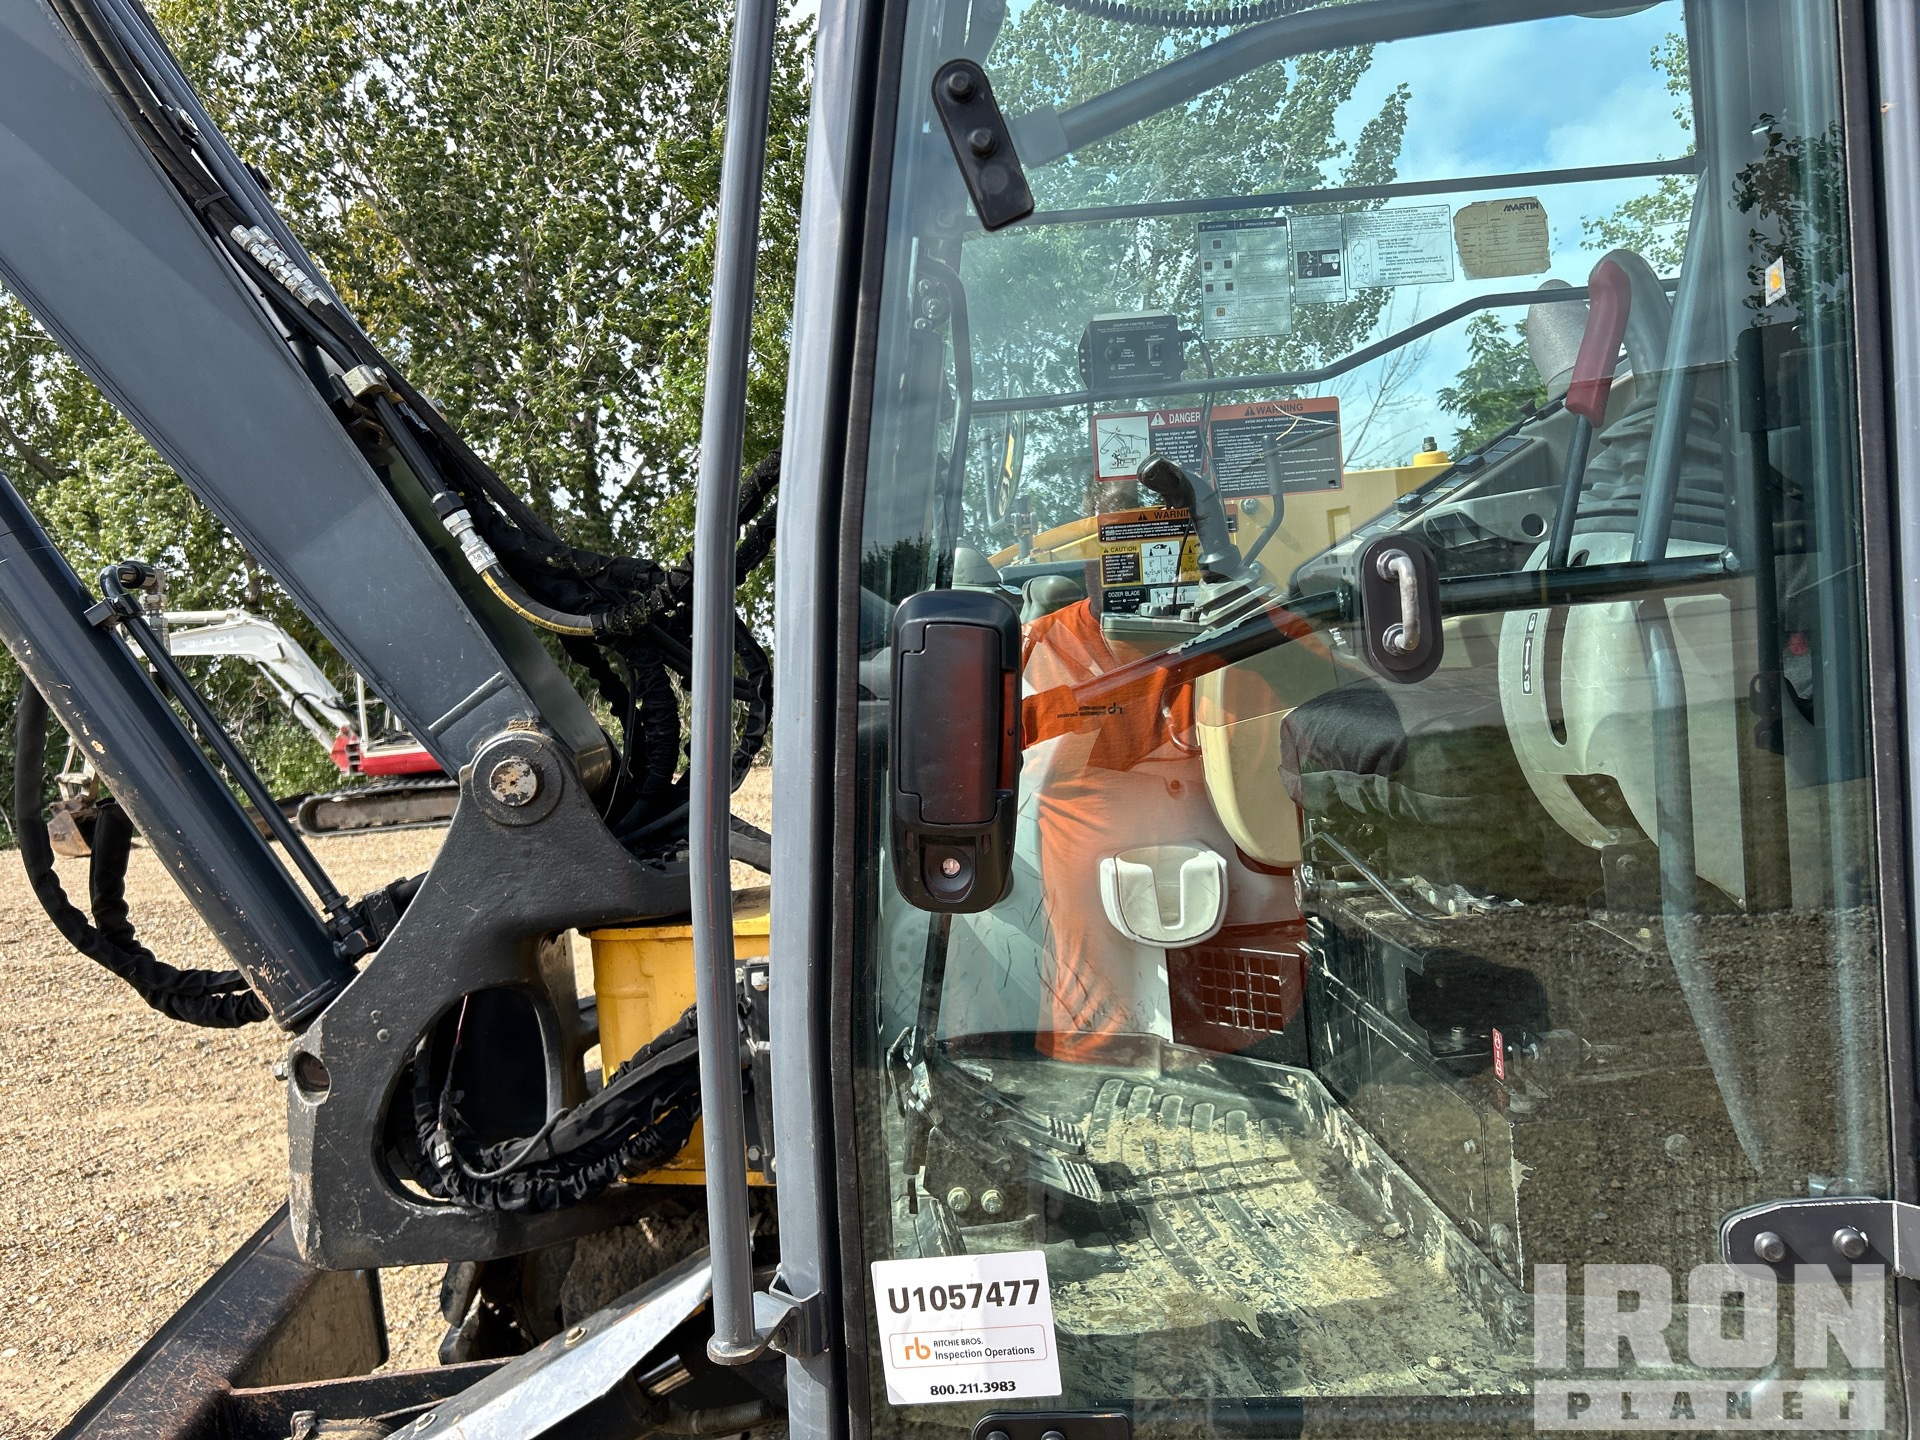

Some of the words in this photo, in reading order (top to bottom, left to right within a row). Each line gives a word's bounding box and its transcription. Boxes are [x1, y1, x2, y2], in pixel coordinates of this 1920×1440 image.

[1503, 202, 1539, 212] MARTIN
[1256, 403, 1304, 415] WARNING
[1169, 411, 1201, 424] DANGER
[1153, 510, 1189, 519] WARNI
[888, 1279, 1040, 1315] U1057477
[904, 1336, 931, 1360] rb
[933, 1339, 960, 1348] RITCHIE
[960, 1337, 984, 1346] BROS.
[935, 1349, 983, 1360] Inspection
[984, 1345, 1035, 1358] Operations
[930, 1380, 1017, 1396] 800.211.3983
